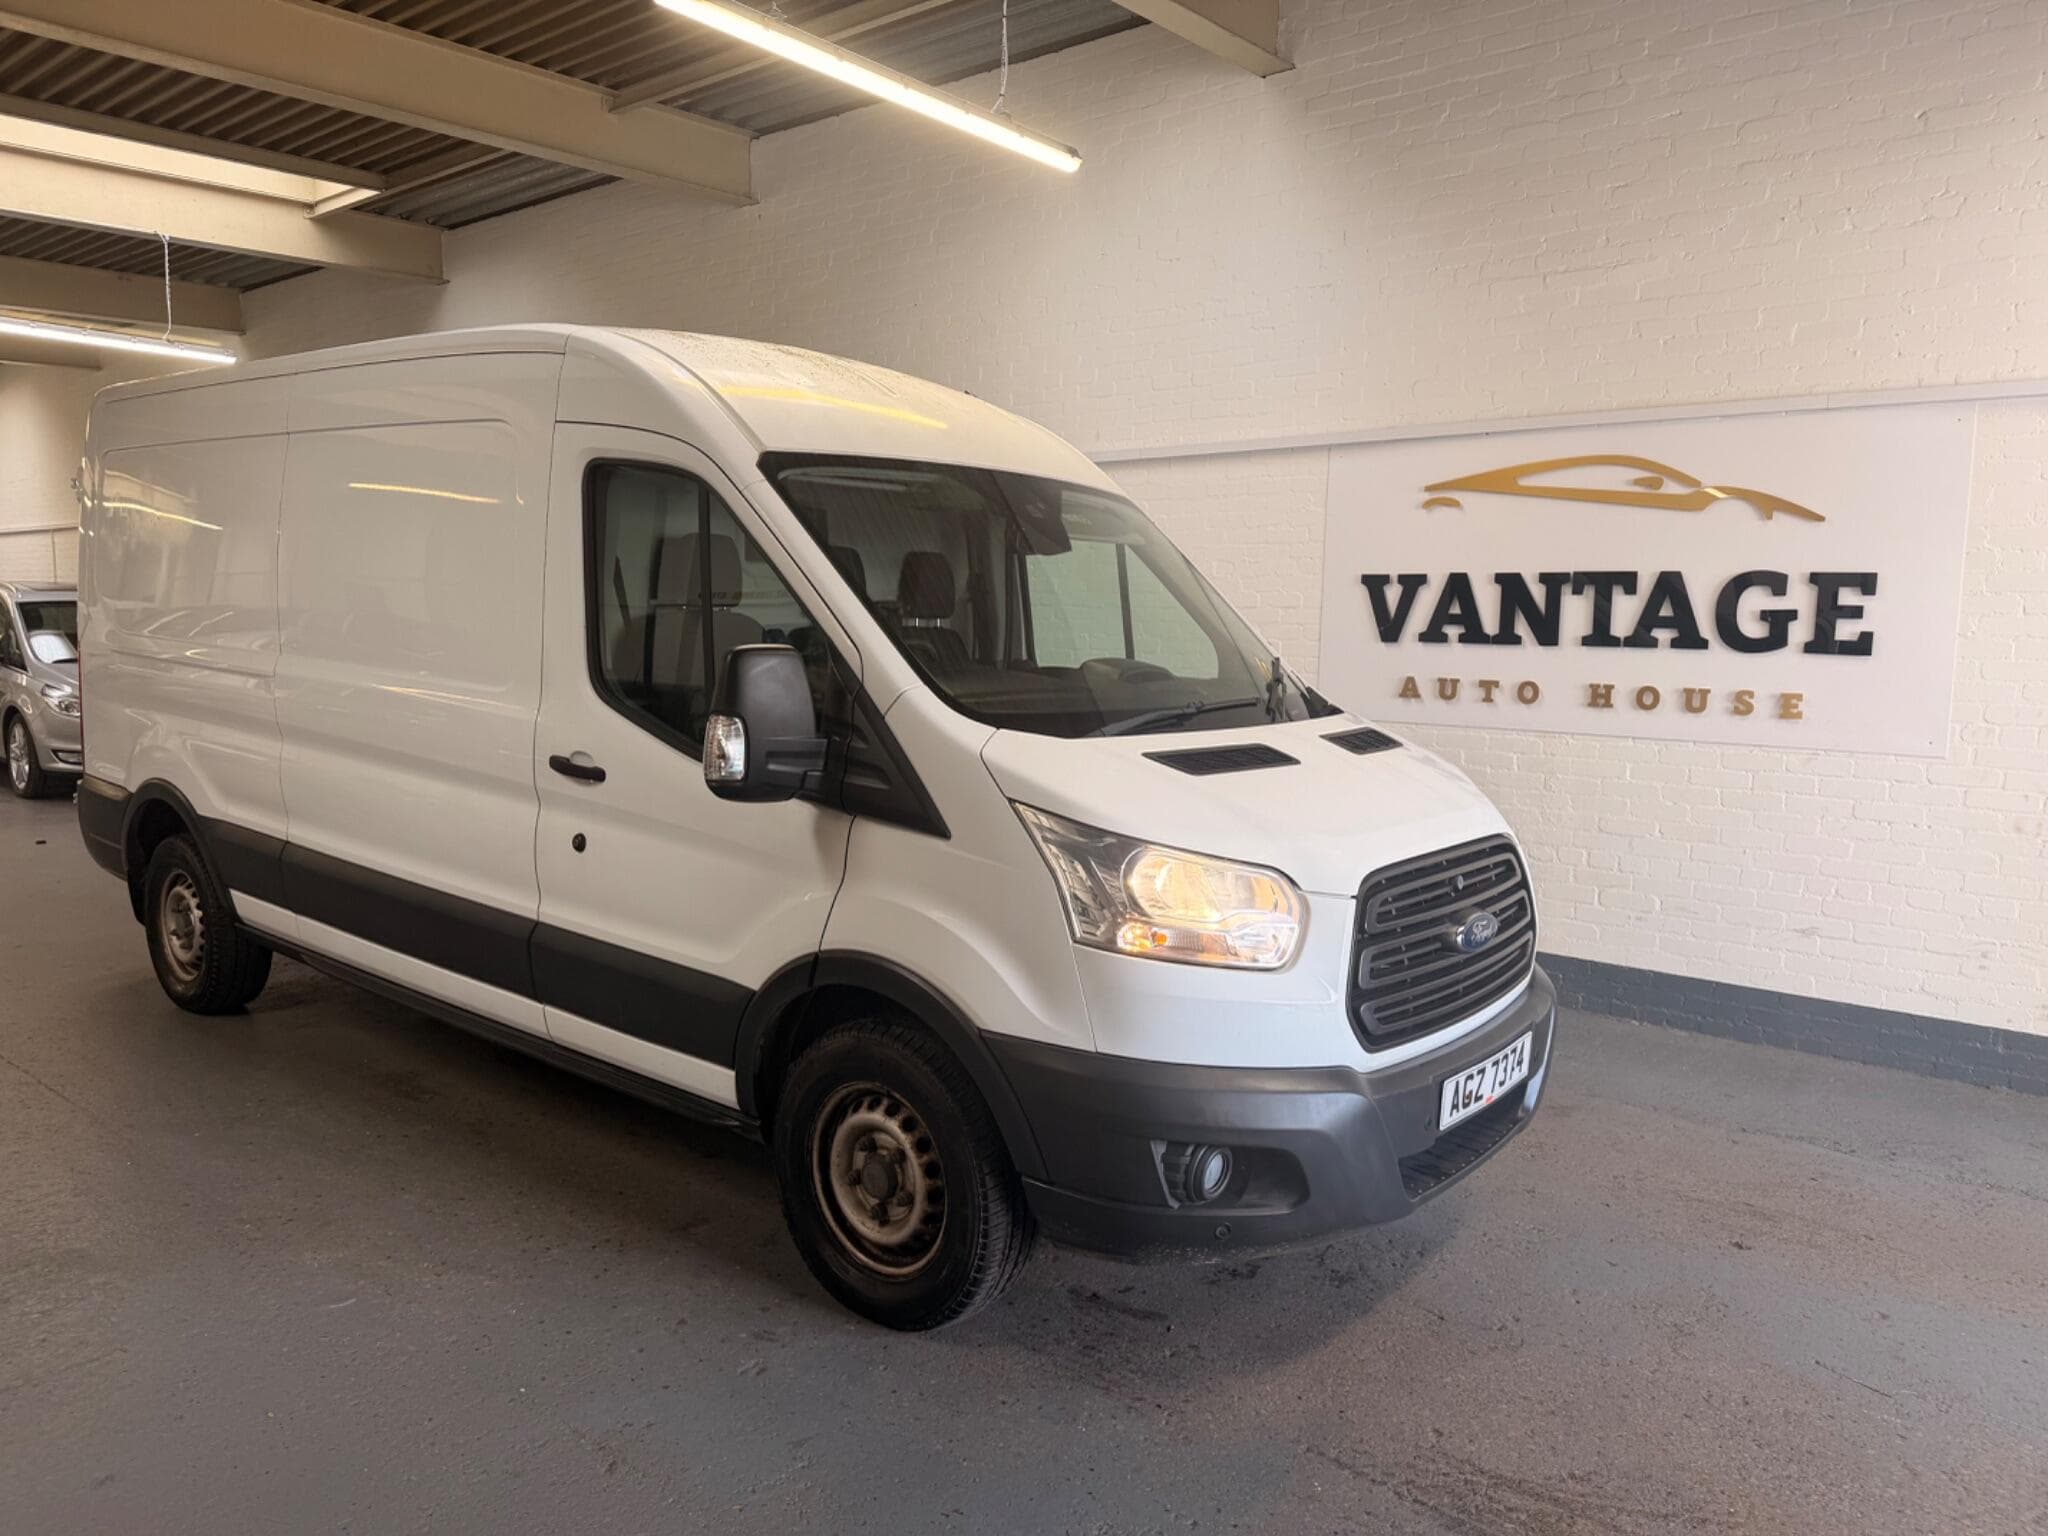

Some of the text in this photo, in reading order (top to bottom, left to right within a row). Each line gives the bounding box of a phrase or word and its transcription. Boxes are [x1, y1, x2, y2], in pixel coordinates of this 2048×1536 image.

[1361, 571, 1877, 656] VANTAGE
[1398, 675, 1805, 721] AUTO HOUSE
[1450, 1040, 1526, 1117] AGZ 7374
